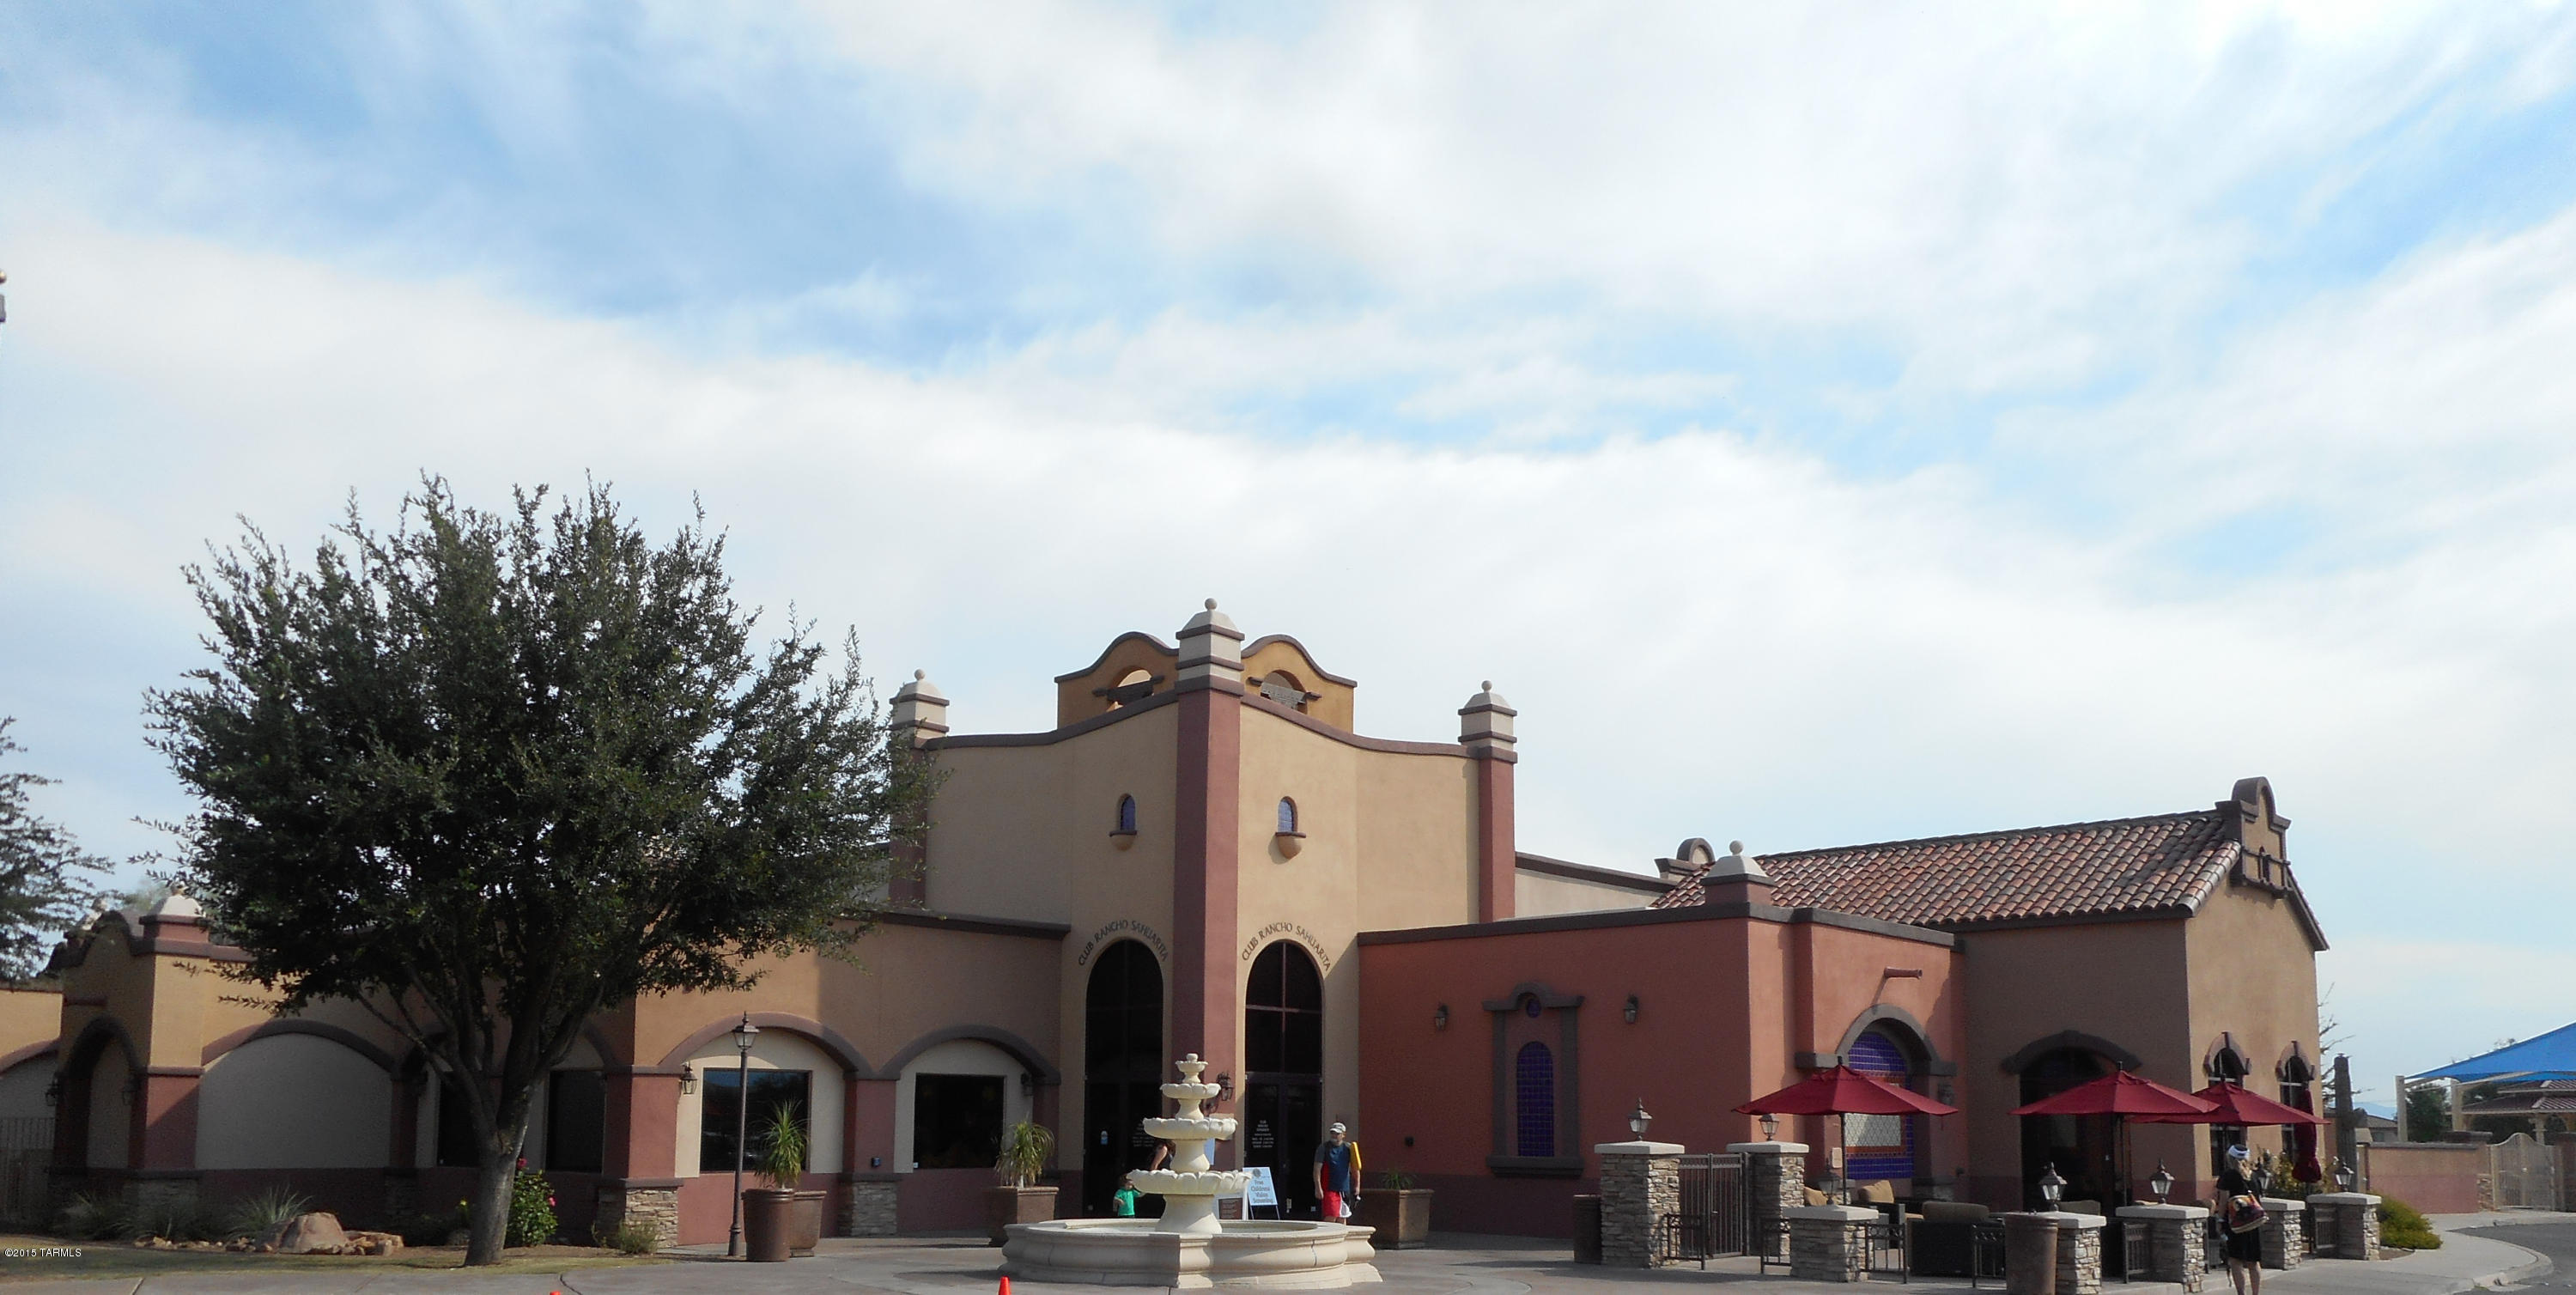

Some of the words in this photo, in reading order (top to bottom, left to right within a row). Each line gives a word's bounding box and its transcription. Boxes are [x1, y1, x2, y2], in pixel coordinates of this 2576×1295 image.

[1078, 941, 1094, 966] CLUB
[1094, 920, 1128, 943] RANCHO
[1132, 920, 1169, 962] SAHUARITA
[1242, 936, 1259, 961] CLUB
[1258, 921, 1293, 940] RANCHO
[1296, 925, 1331, 971] SAHUARITA
